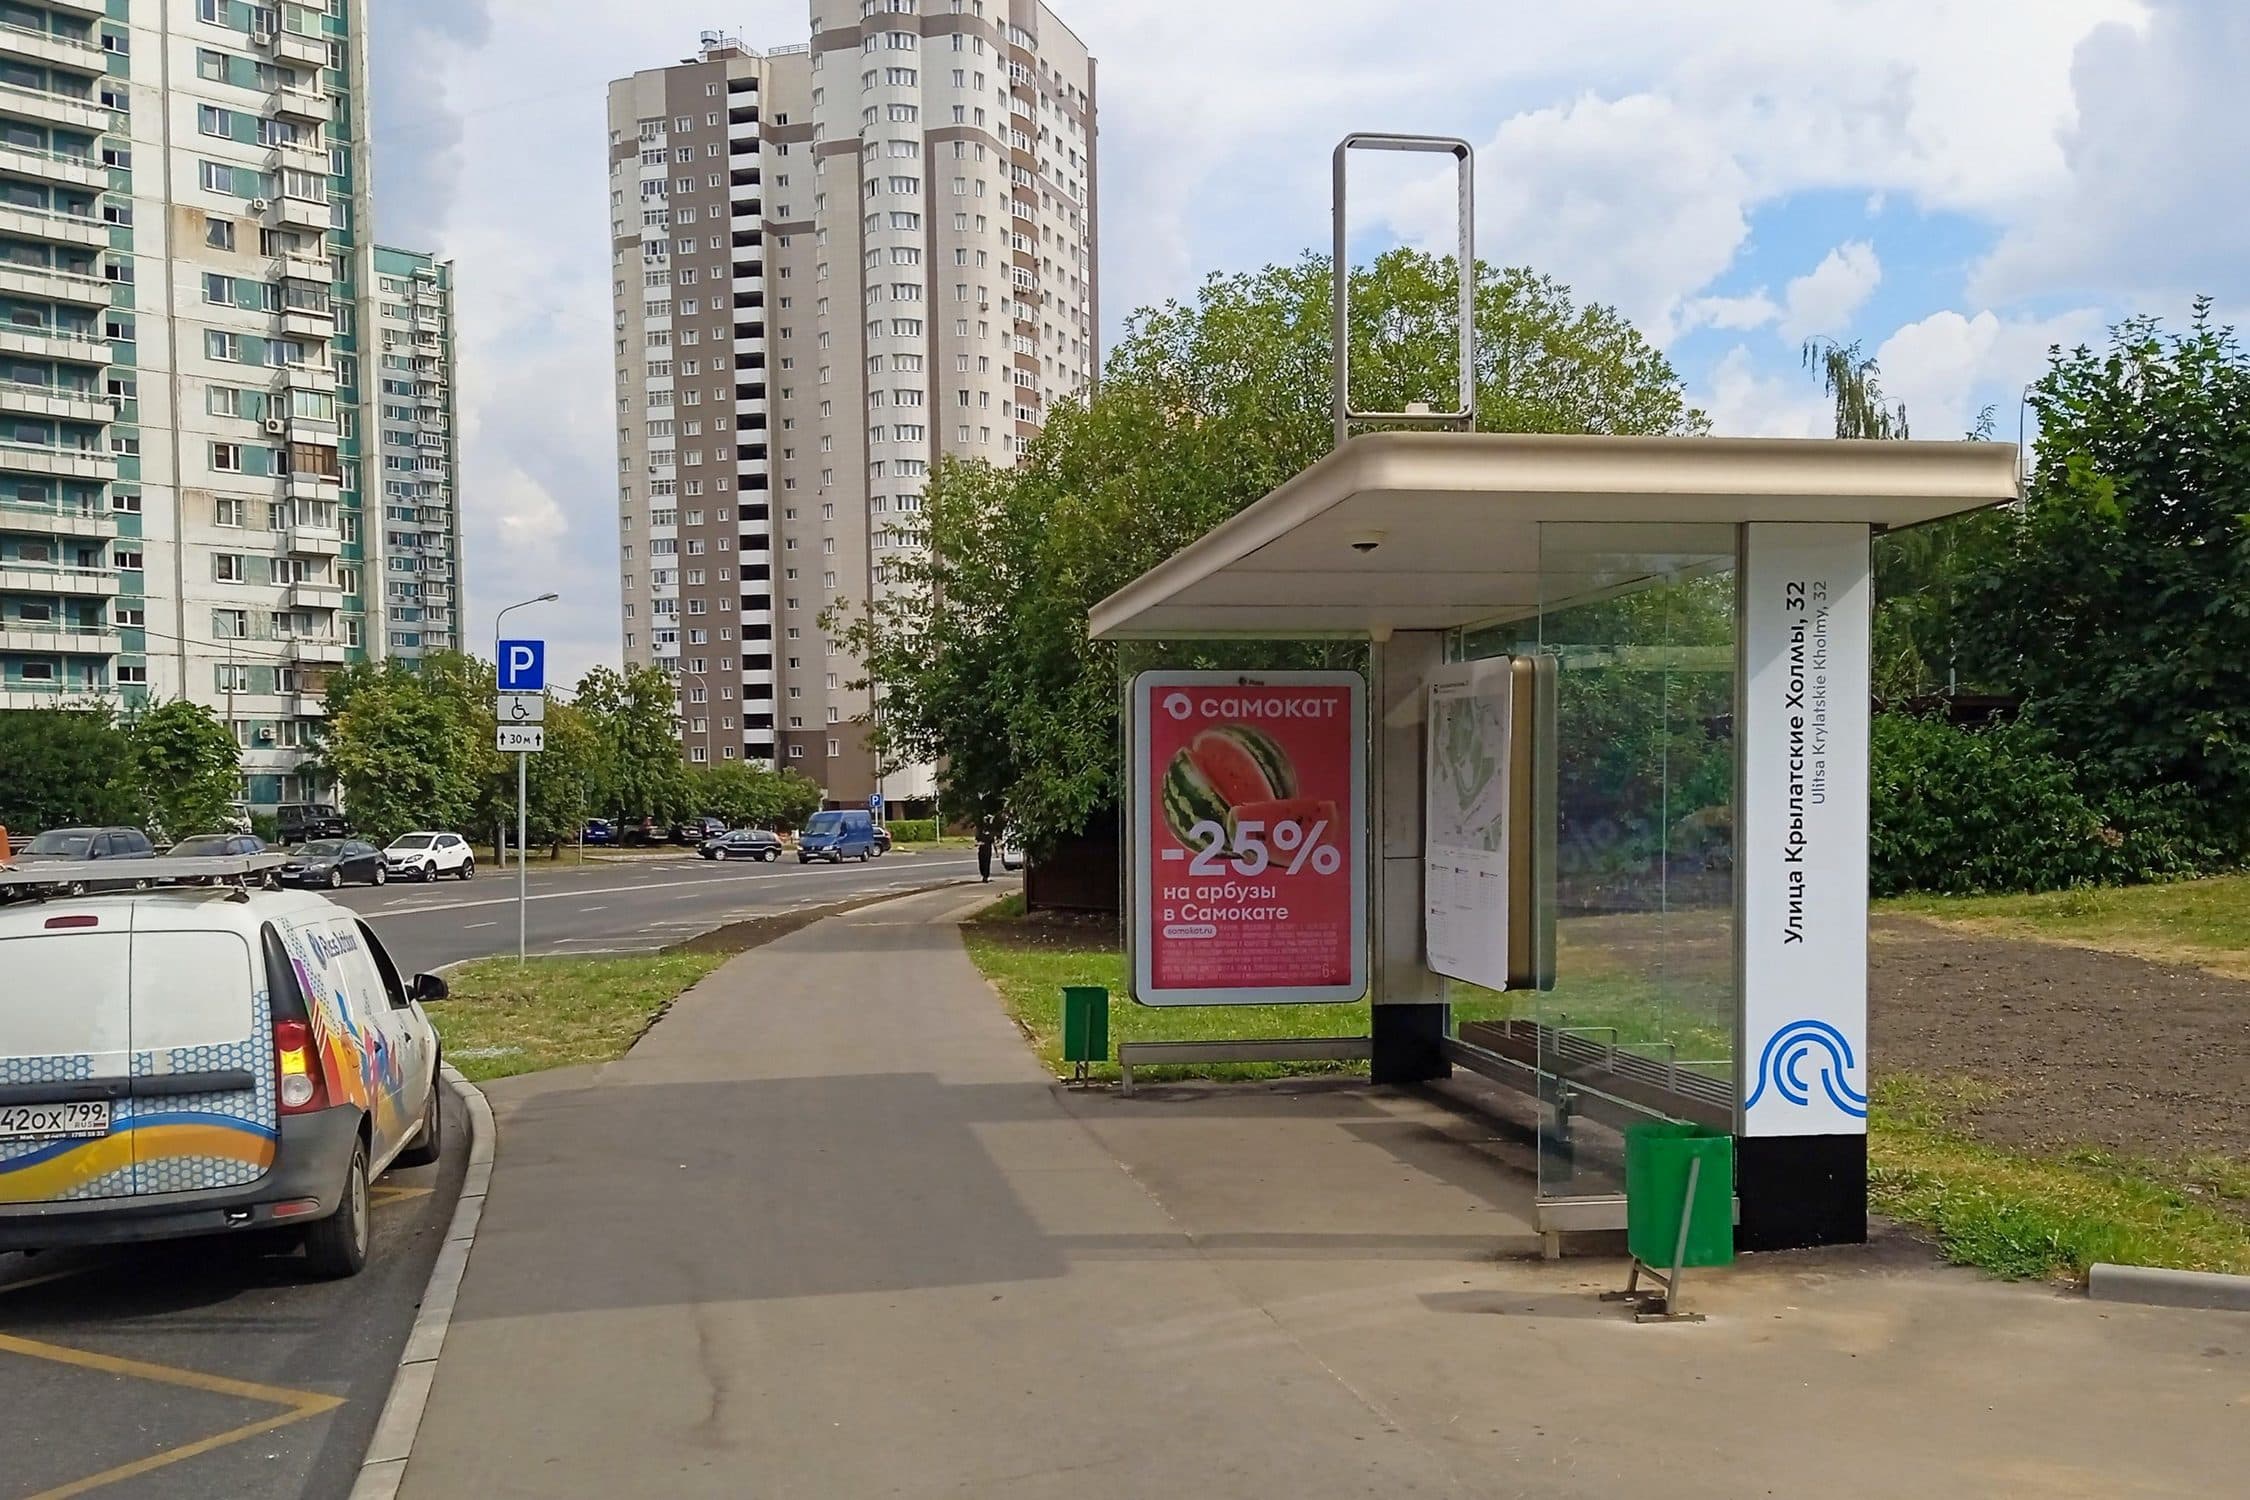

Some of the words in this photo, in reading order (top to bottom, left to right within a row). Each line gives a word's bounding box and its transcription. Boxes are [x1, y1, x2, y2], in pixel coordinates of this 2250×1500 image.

[1785, 581, 1806, 611] 32
[1813, 580, 1828, 601] 32
[1812, 607, 1830, 671] Kholmy,
[510, 646, 534, 684] P
[1785, 618, 1808, 710] Холмы,
[1200, 698, 1338, 718] самокат
[1812, 674, 1828, 755] Krylatskie
[1784, 716, 1808, 863] Крылатские
[1812, 760, 1827, 805] Ulitsa
[1161, 820, 1341, 877] -25%
[1163, 886, 1190, 900] на
[1196, 881, 1276, 904] арбузы
[1784, 870, 1806, 945] Улица
[1163, 908, 1175, 921] в
[1181, 904, 1289, 921] Самокате
[1321, 964, 1337, 978] 6+
[66, 1103, 104, 1122] 799
